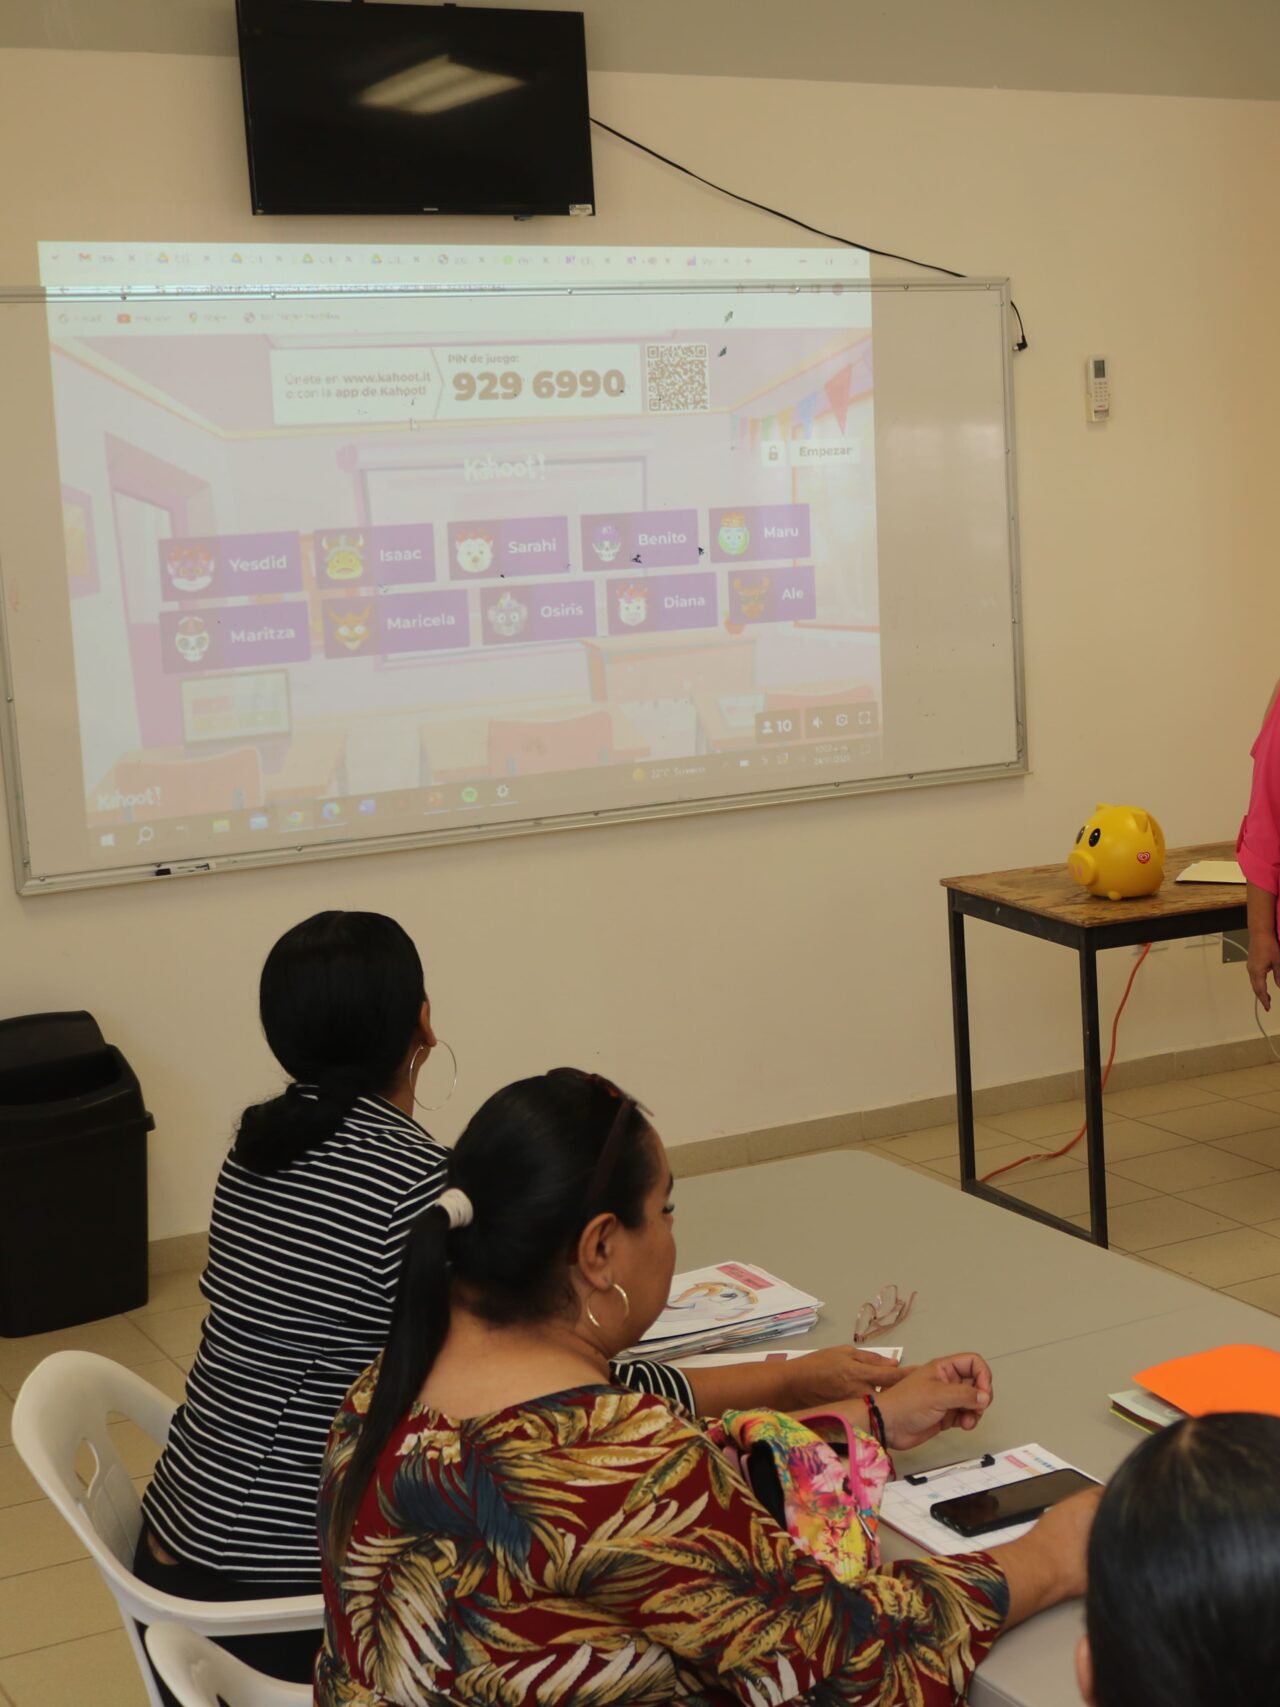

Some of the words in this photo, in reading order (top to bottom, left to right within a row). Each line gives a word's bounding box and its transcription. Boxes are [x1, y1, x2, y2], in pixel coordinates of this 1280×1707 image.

[448, 354, 467, 364] PIN
[470, 354, 483, 363] de
[486, 354, 519, 365] juego:
[343, 371, 431, 384] www.kahoot.it
[452, 371, 522, 401] 929
[532, 369, 625, 399] 6990
[322, 387, 332, 398] la
[335, 388, 358, 400] app
[362, 386, 377, 397] de
[800, 445, 852, 459] Empezar
[464, 452, 545, 481] Kahoot!
[638, 531, 686, 547] Benito
[764, 525, 798, 539] Maru
[508, 538, 556, 554] Sarahi
[380, 548, 422, 563] Isaac
[229, 555, 287, 572] Yesdid
[782, 587, 803, 600] Ale
[664, 595, 705, 609] Diana
[541, 603, 584, 618] Osiris
[386, 614, 455, 631] Maricela
[231, 627, 295, 643] Maritza
[777, 719, 792, 733] 10
